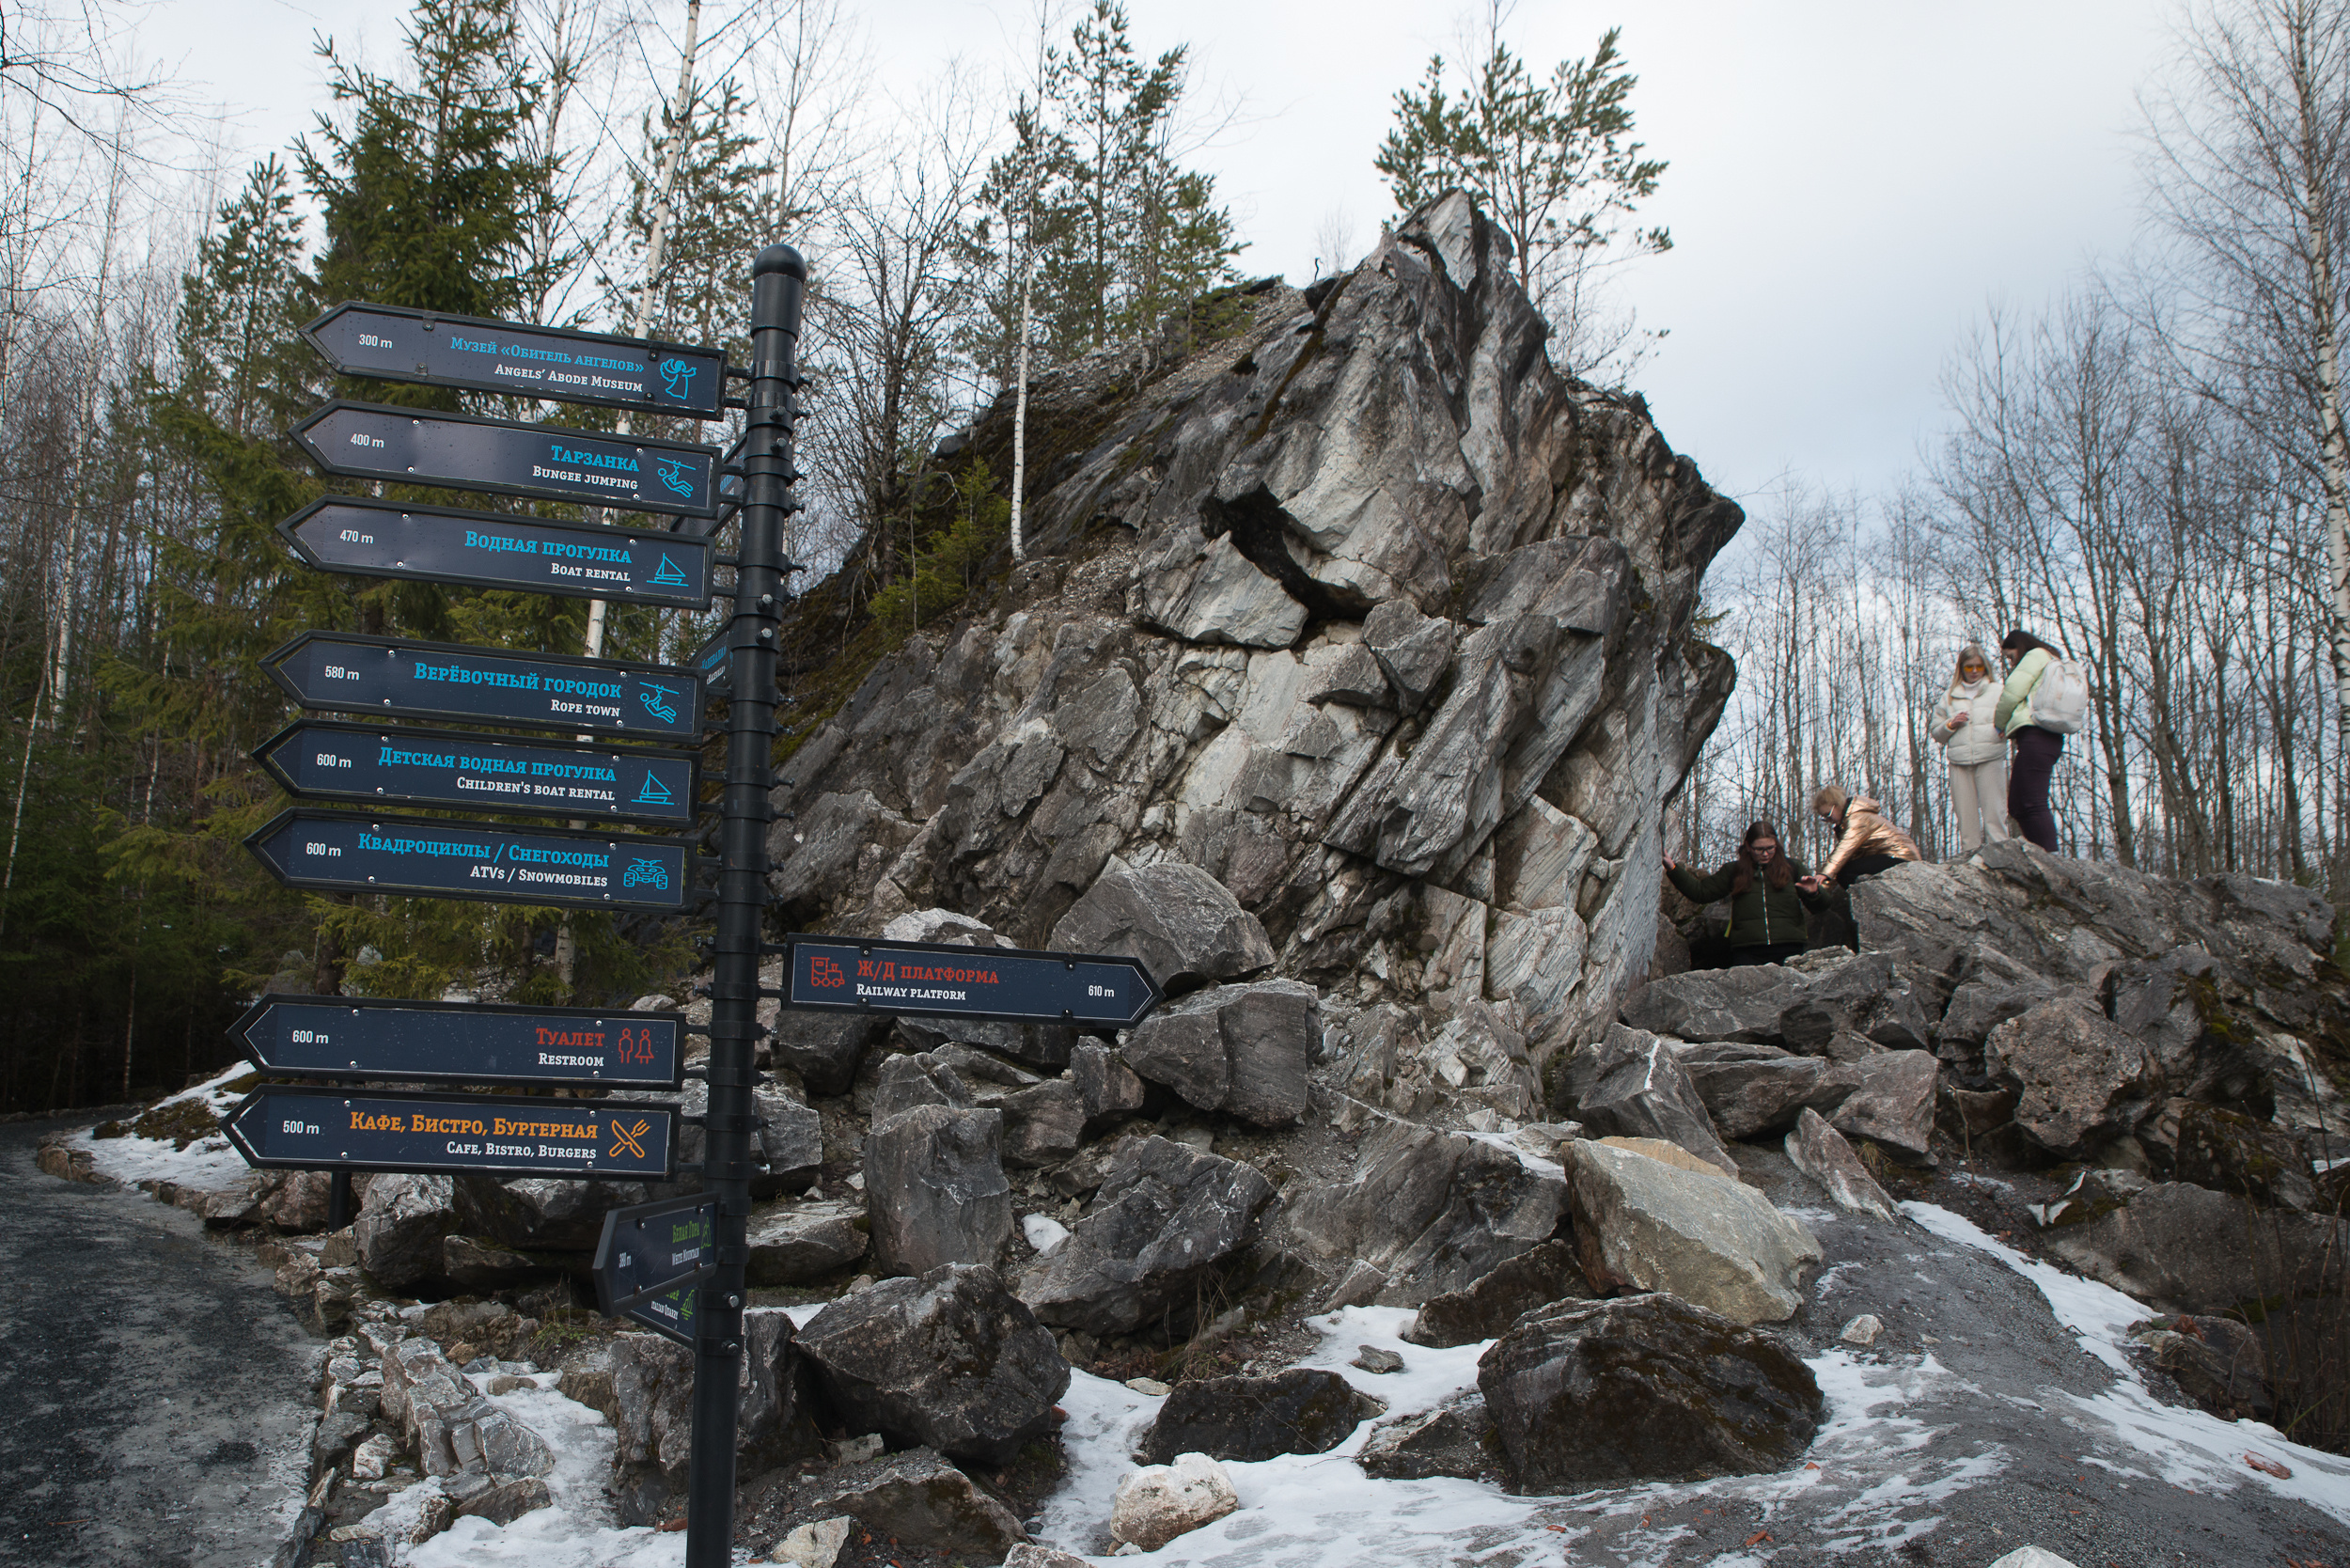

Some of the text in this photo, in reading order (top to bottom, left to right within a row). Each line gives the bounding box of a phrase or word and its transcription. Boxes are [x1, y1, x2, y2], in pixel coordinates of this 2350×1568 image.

[358, 334, 393, 350] 300 m
[351, 433, 384, 447] 400 m
[339, 529, 373, 543] 470 m
[325, 666, 359, 680] 580 m
[317, 754, 352, 768] 600 m
[306, 842, 341, 856] 600 m
[1089, 985, 1102, 996] 610
[292, 1030, 328, 1043] 600 m
[283, 1121, 319, 1134] 500 m
[626, 1255, 632, 1265] m
